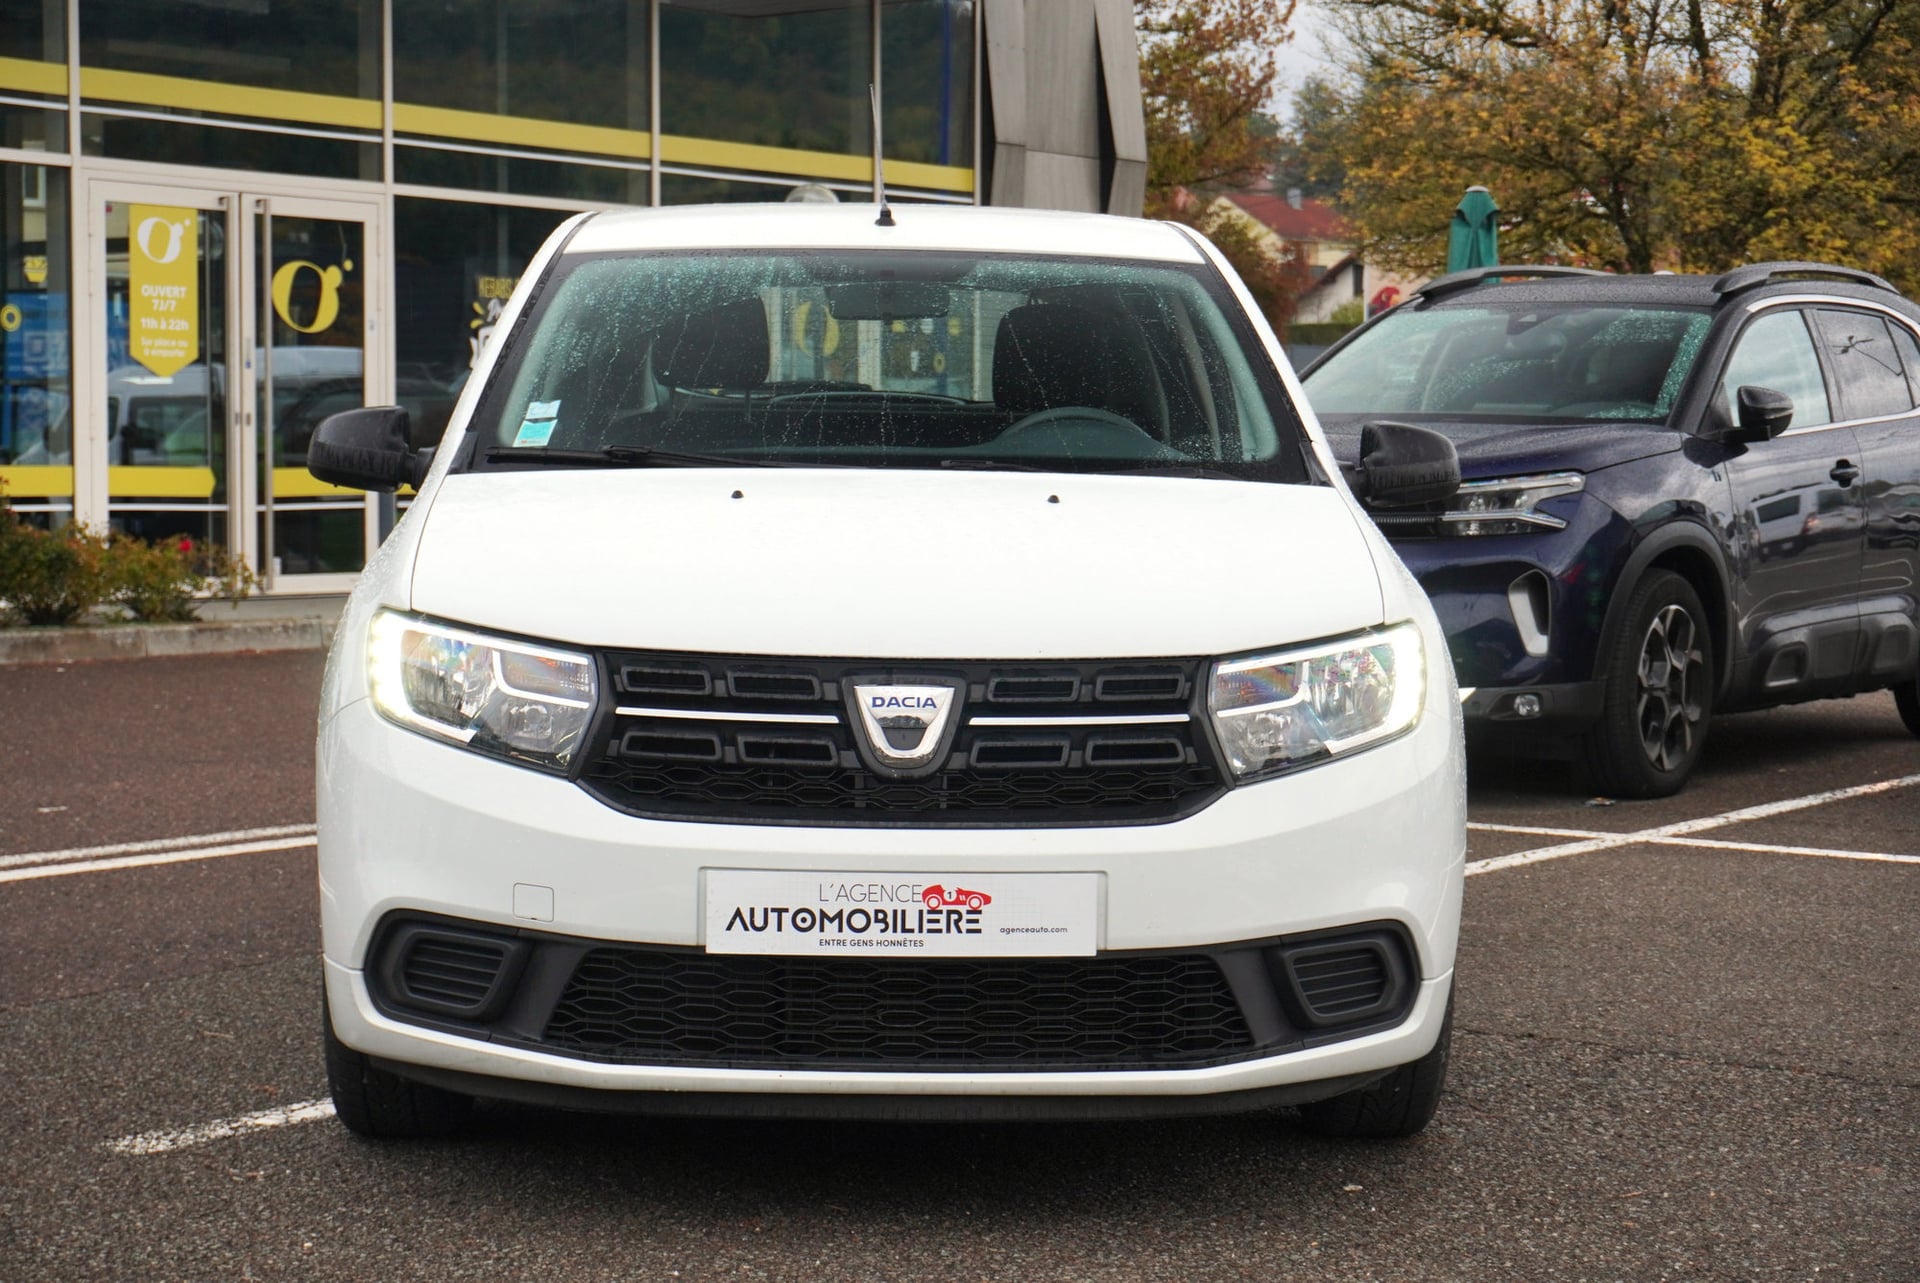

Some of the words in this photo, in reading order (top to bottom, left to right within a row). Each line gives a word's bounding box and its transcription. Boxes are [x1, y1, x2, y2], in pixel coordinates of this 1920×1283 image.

[142, 285, 187, 298] OUVERT
[168, 319, 189, 331] 22h
[872, 696, 937, 708] DACIA
[819, 884, 923, 903] L'AGENCE
[999, 926, 1068, 935] agenceauto.com
[819, 938, 847, 947] ENTRE
[850, 938, 874, 947] GENS
[876, 937, 924, 947] HONNÊTES
